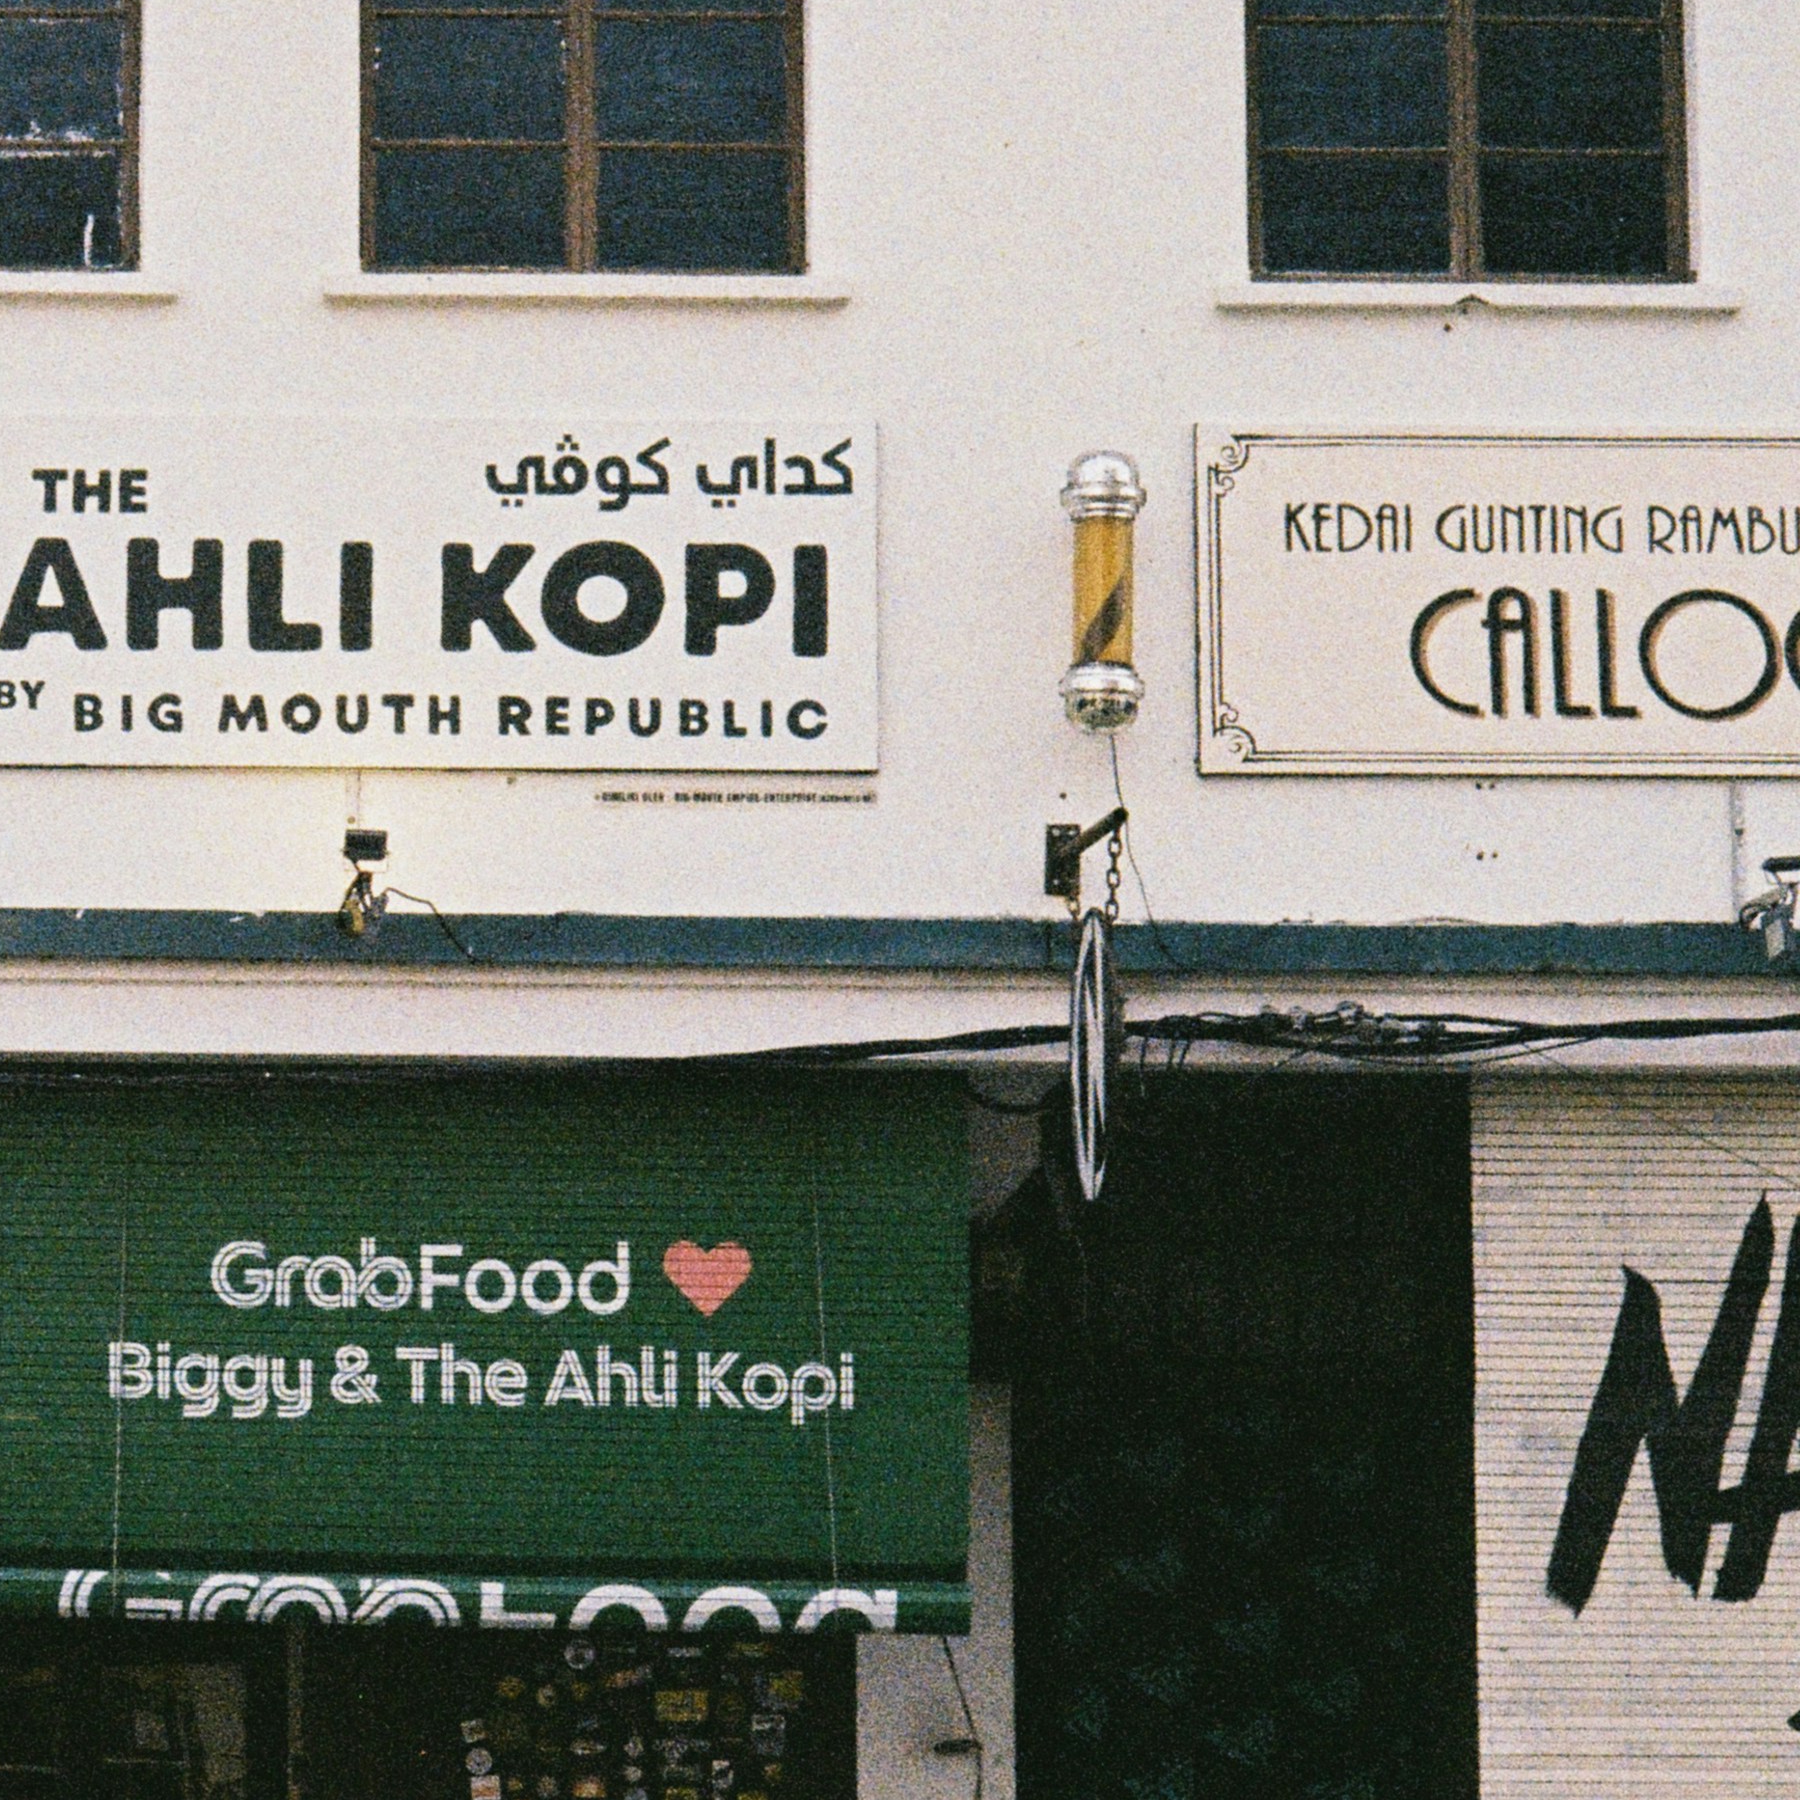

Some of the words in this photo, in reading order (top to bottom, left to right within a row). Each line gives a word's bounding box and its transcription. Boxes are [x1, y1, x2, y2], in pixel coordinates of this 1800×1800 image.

[31, 468, 149, 514] THE
[695, 437, 854, 509] كداي
[1283, 502, 1413, 554] KEDAI
[1434, 504, 1625, 554] GUNTING
[1647, 503, 1800, 556] RAMBU
[440, 540, 830, 658] KOPI
[1409, 585, 1800, 723] CALLO
[73, 693, 185, 734] BIG
[218, 693, 462, 736] MOUTH
[498, 695, 829, 740] REPUBLIC
[209, 1236, 631, 1317] GrabFood
[108, 1340, 314, 1419] Biggy
[329, 1343, 382, 1405] &
[395, 1342, 529, 1408] The
[544, 1344, 679, 1408] Ahli
[696, 1351, 856, 1426] Kopi
